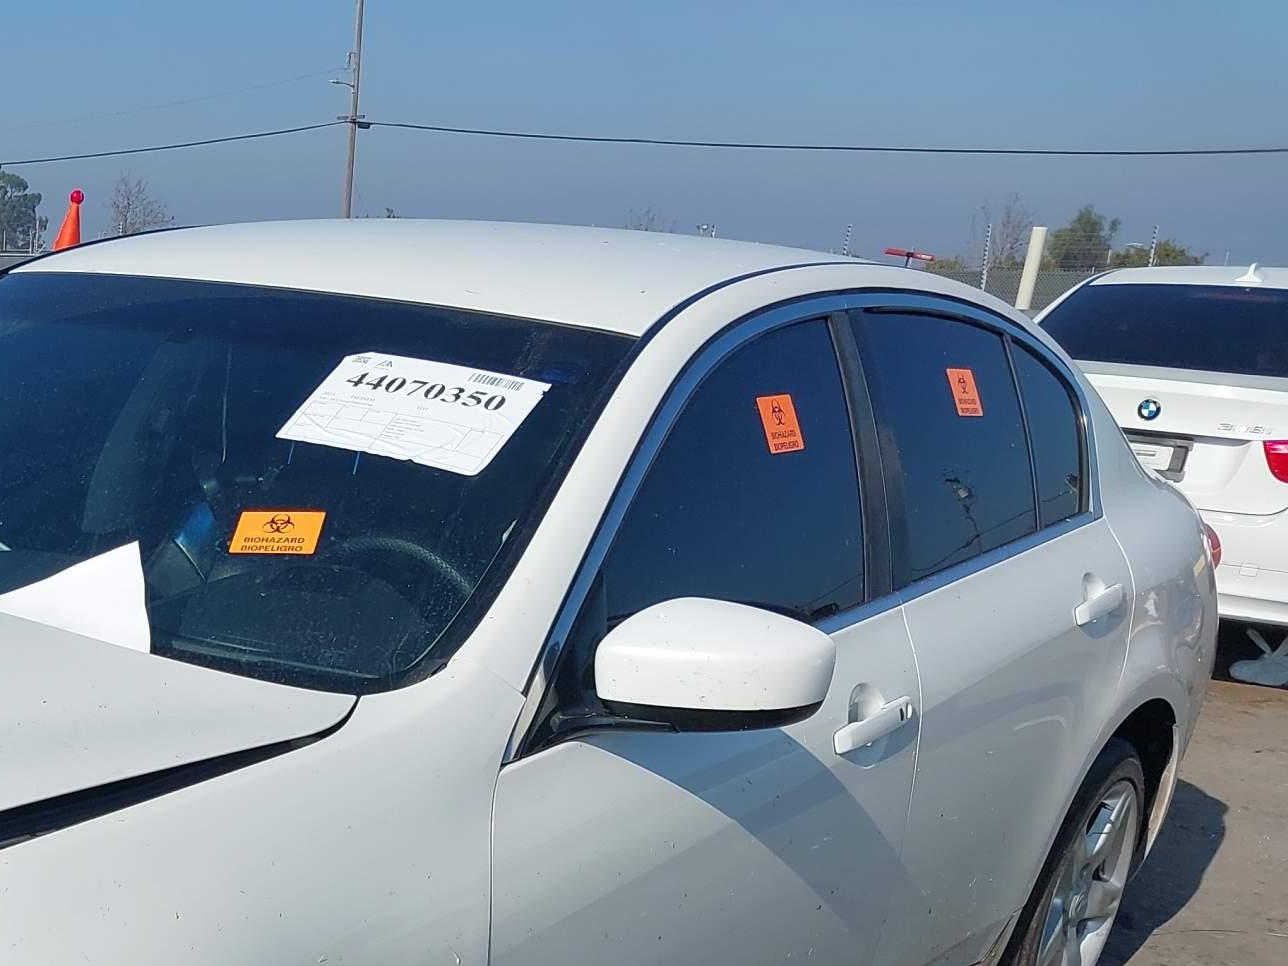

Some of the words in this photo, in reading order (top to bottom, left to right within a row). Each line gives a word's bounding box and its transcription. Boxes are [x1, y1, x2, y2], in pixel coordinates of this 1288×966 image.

[346, 372, 507, 411] 44070350
[771, 430, 796, 440] BIOHAZARD
[243, 536, 306, 544] BIOHAZARD
